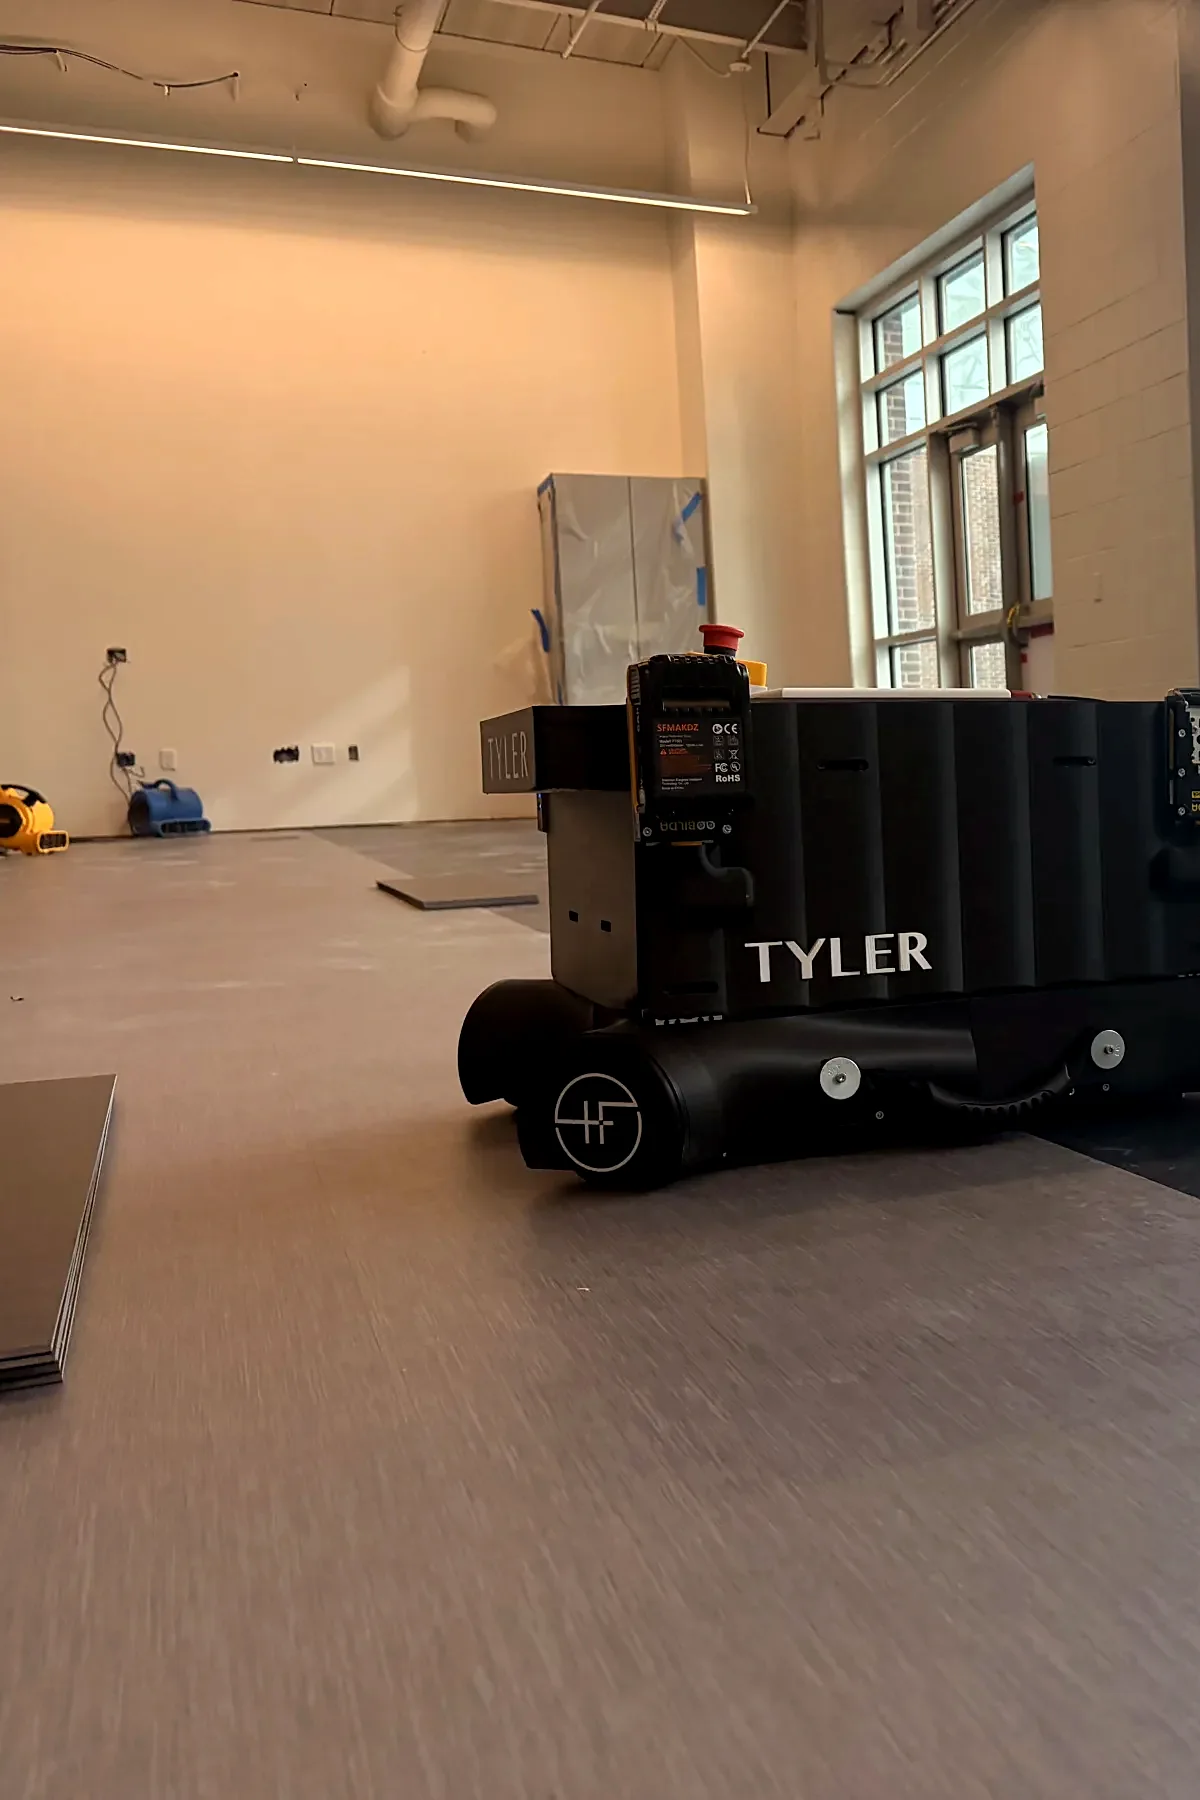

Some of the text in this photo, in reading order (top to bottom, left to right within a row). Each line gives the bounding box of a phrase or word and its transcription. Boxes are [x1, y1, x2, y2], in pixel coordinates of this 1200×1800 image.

[656, 723, 699, 732] SFMAKDZ
[487, 730, 529, 781] TYLER
[715, 774, 741, 783] RoHS
[744, 931, 933, 983] TYLER
